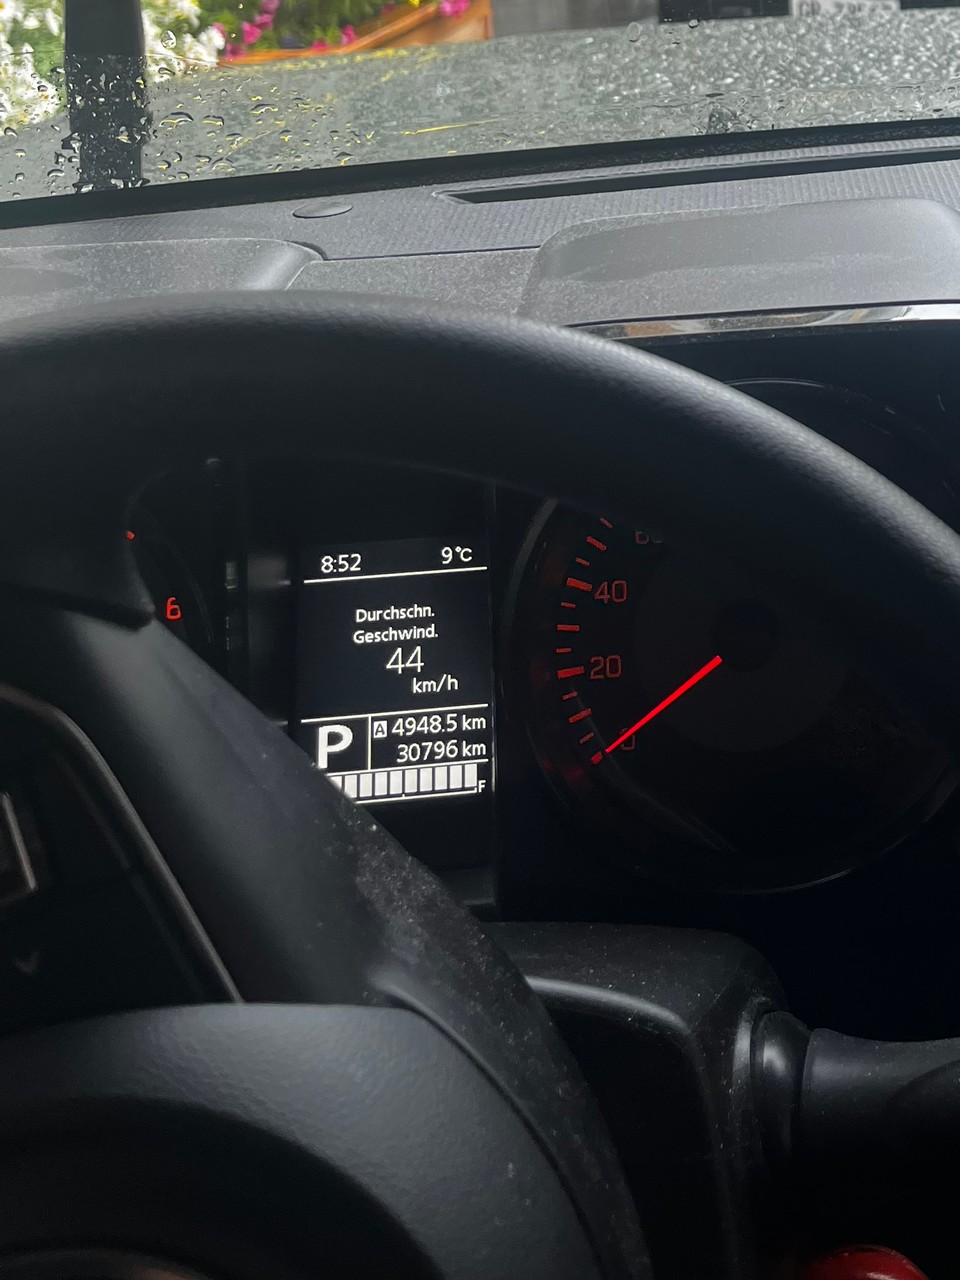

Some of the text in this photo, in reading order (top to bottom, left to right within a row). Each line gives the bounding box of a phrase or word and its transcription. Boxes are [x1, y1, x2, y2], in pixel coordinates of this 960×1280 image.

[321, 553, 361, 573] 8:52
[594, 580, 627, 603] 40
[166, 595, 182, 621] 6
[355, 604, 435, 622] Durchschn.
[353, 624, 438, 643] Geschwind.
[386, 646, 424, 674] 44
[590, 654, 622, 681] 20
[412, 674, 459, 693] km/h
[374, 713, 486, 738] A 4948.5 km
[318, 724, 353, 769] P
[397, 740, 486, 763] 30796 km
[478, 780, 486, 793] F
